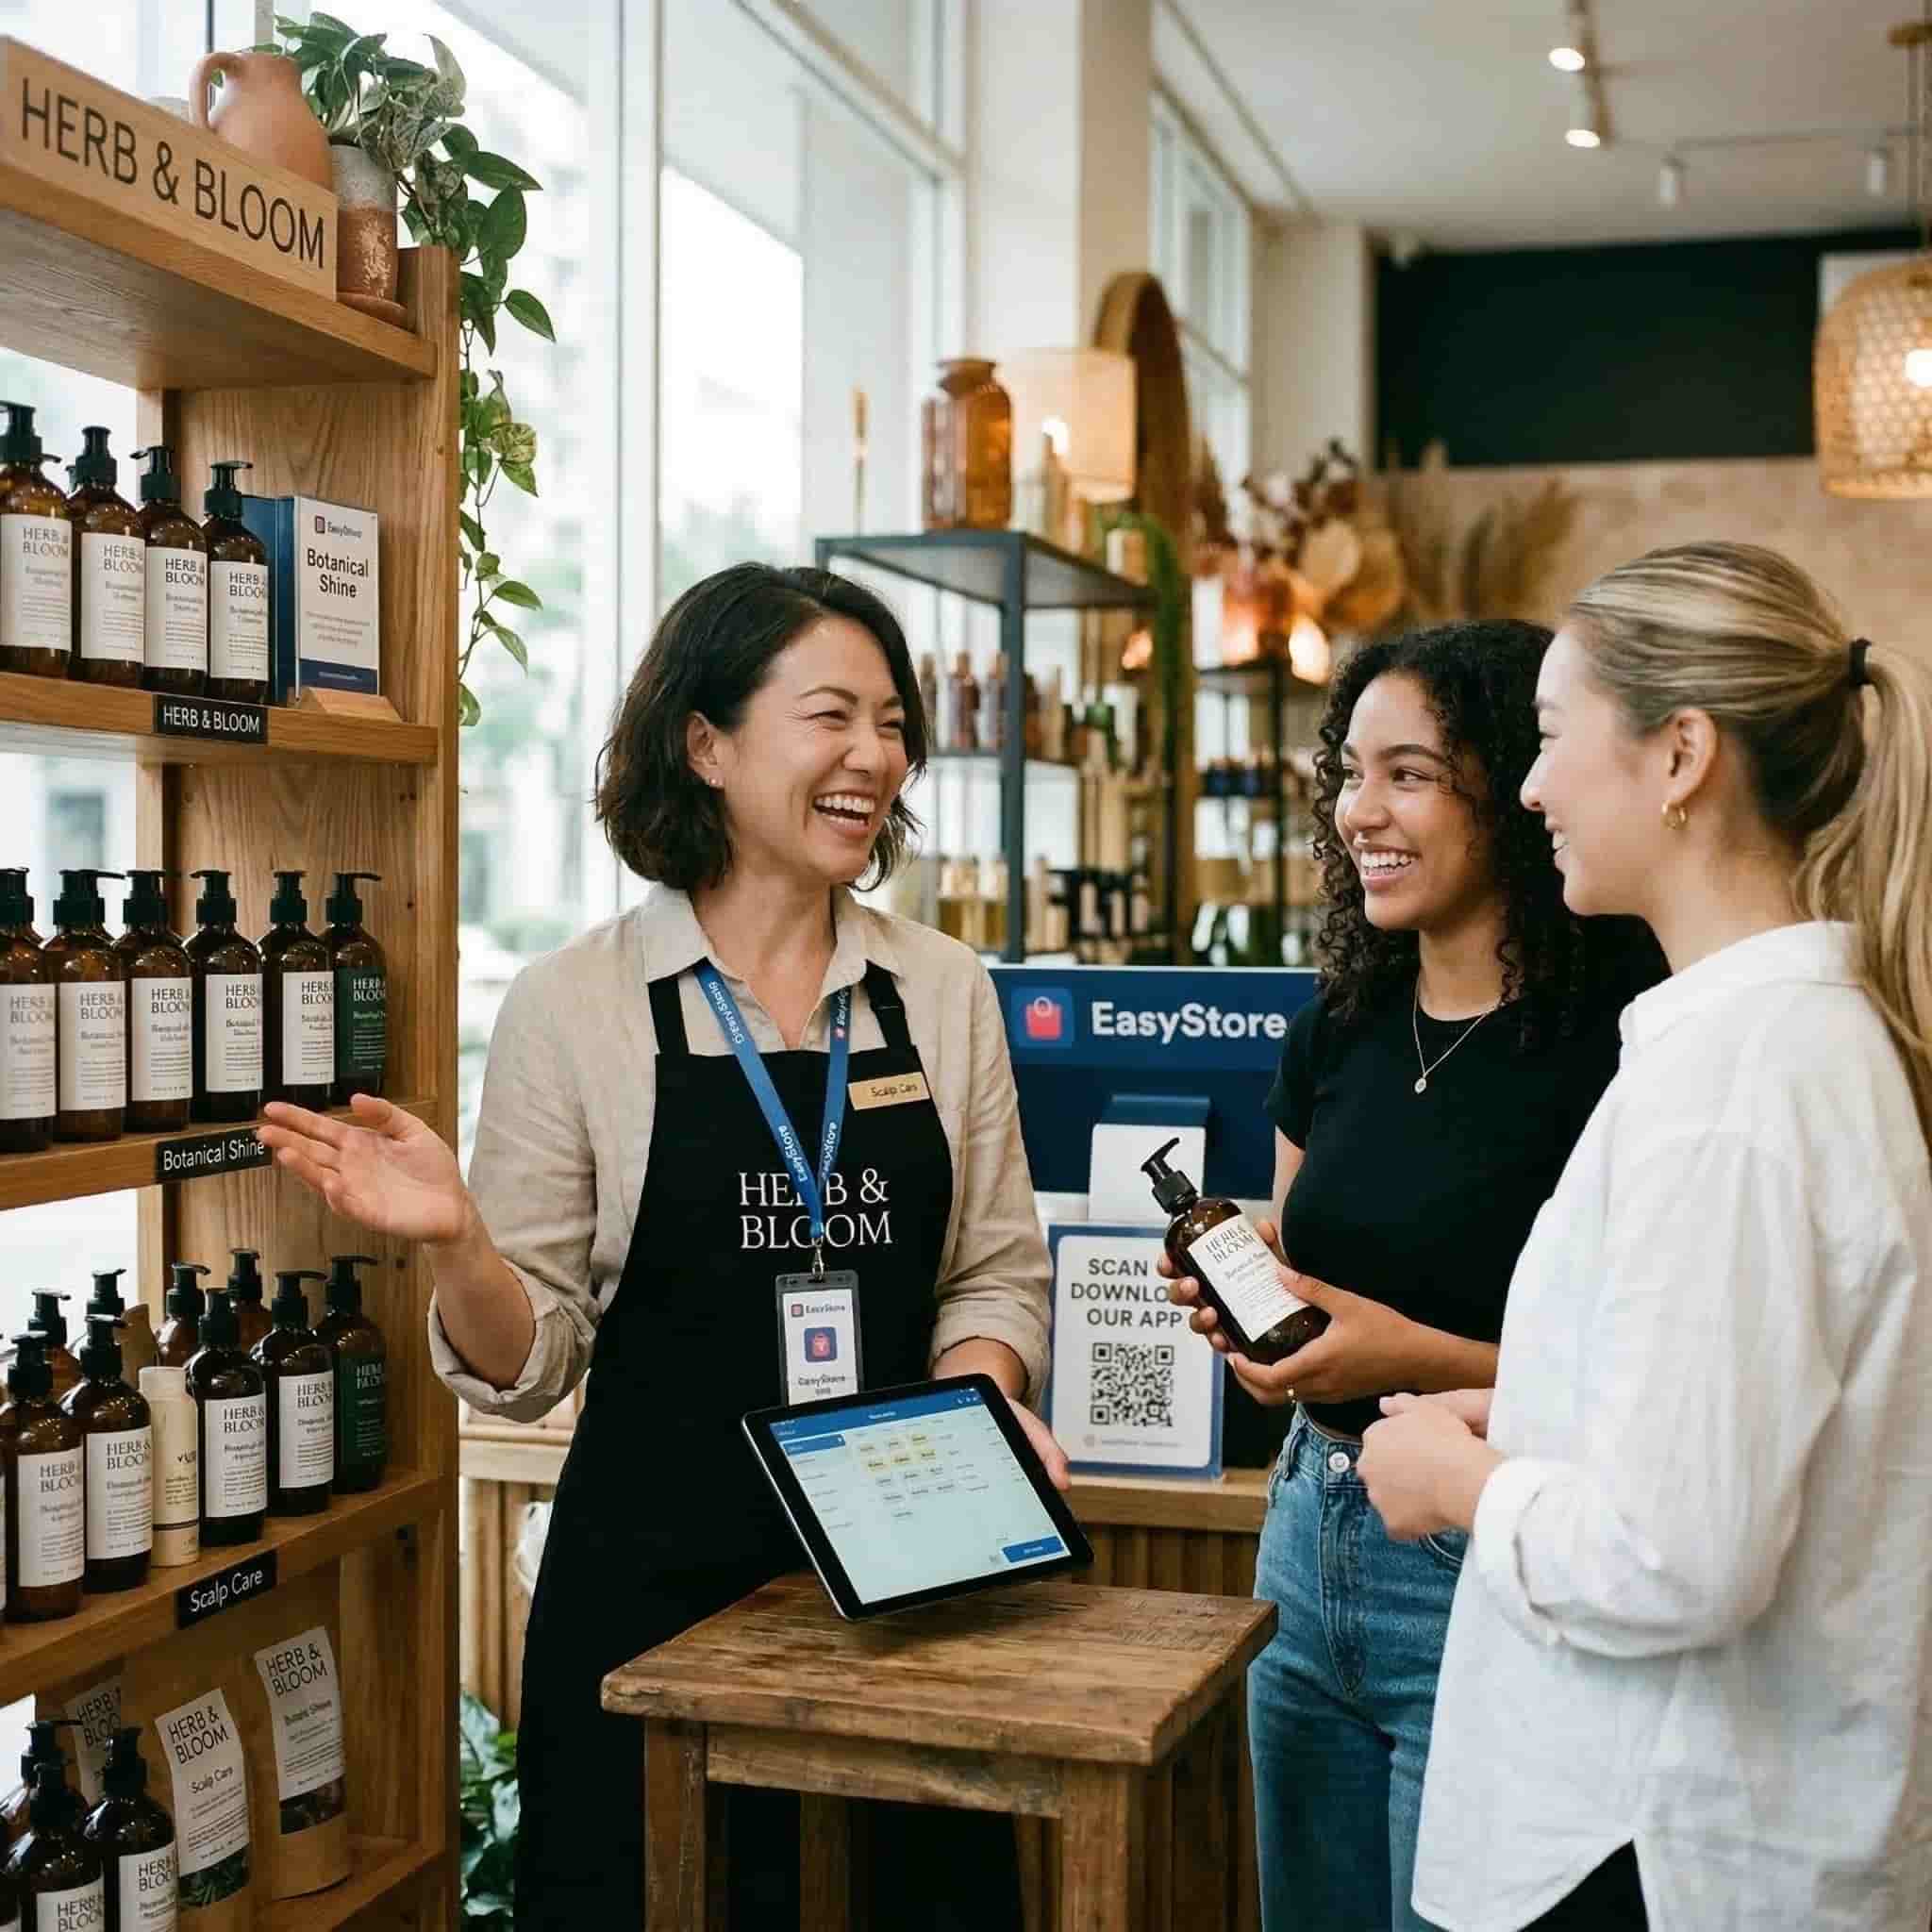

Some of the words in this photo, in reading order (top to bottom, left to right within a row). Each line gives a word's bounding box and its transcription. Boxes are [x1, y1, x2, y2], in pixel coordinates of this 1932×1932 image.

[22, 77, 138, 185] HERB
[152, 141, 179, 205] &
[194, 158, 325, 270] BLOOM
[165, 558, 197, 572] HERB
[308, 548, 369, 577] Botanical
[229, 572, 258, 585] HERB
[320, 574, 357, 598] Shine
[163, 705, 198, 727] HERB
[202, 709, 212, 729] &
[213, 710, 259, 733] BLOOM
[151, 989, 184, 1001] HERB
[1091, 1001, 1288, 1044] EasyStore
[163, 1140, 225, 1171] Botanical
[228, 1135, 265, 1160] Shine
[740, 1172, 847, 1208] HEB
[859, 1168, 890, 1204] &
[740, 1210, 893, 1250] BLOOM
[1088, 1257, 1149, 1276] SCAN
[1071, 1282, 1170, 1304] DOWNLO
[1086, 1307, 1133, 1326] OUR
[1139, 1310, 1183, 1328] APP
[224, 1405, 257, 1421] HERB
[106, 1440, 142, 1457] HERB
[190, 1578, 228, 1612] Scalp
[231, 1570, 264, 1594] Care
[266, 1647, 307, 1677] HERB
[308, 1642, 322, 1660] &
[271, 1659, 329, 1698] BLOOM
[167, 1710, 207, 1745] HERB
[208, 1705, 220, 1724] &
[175, 1722, 229, 1765] BLOOM
